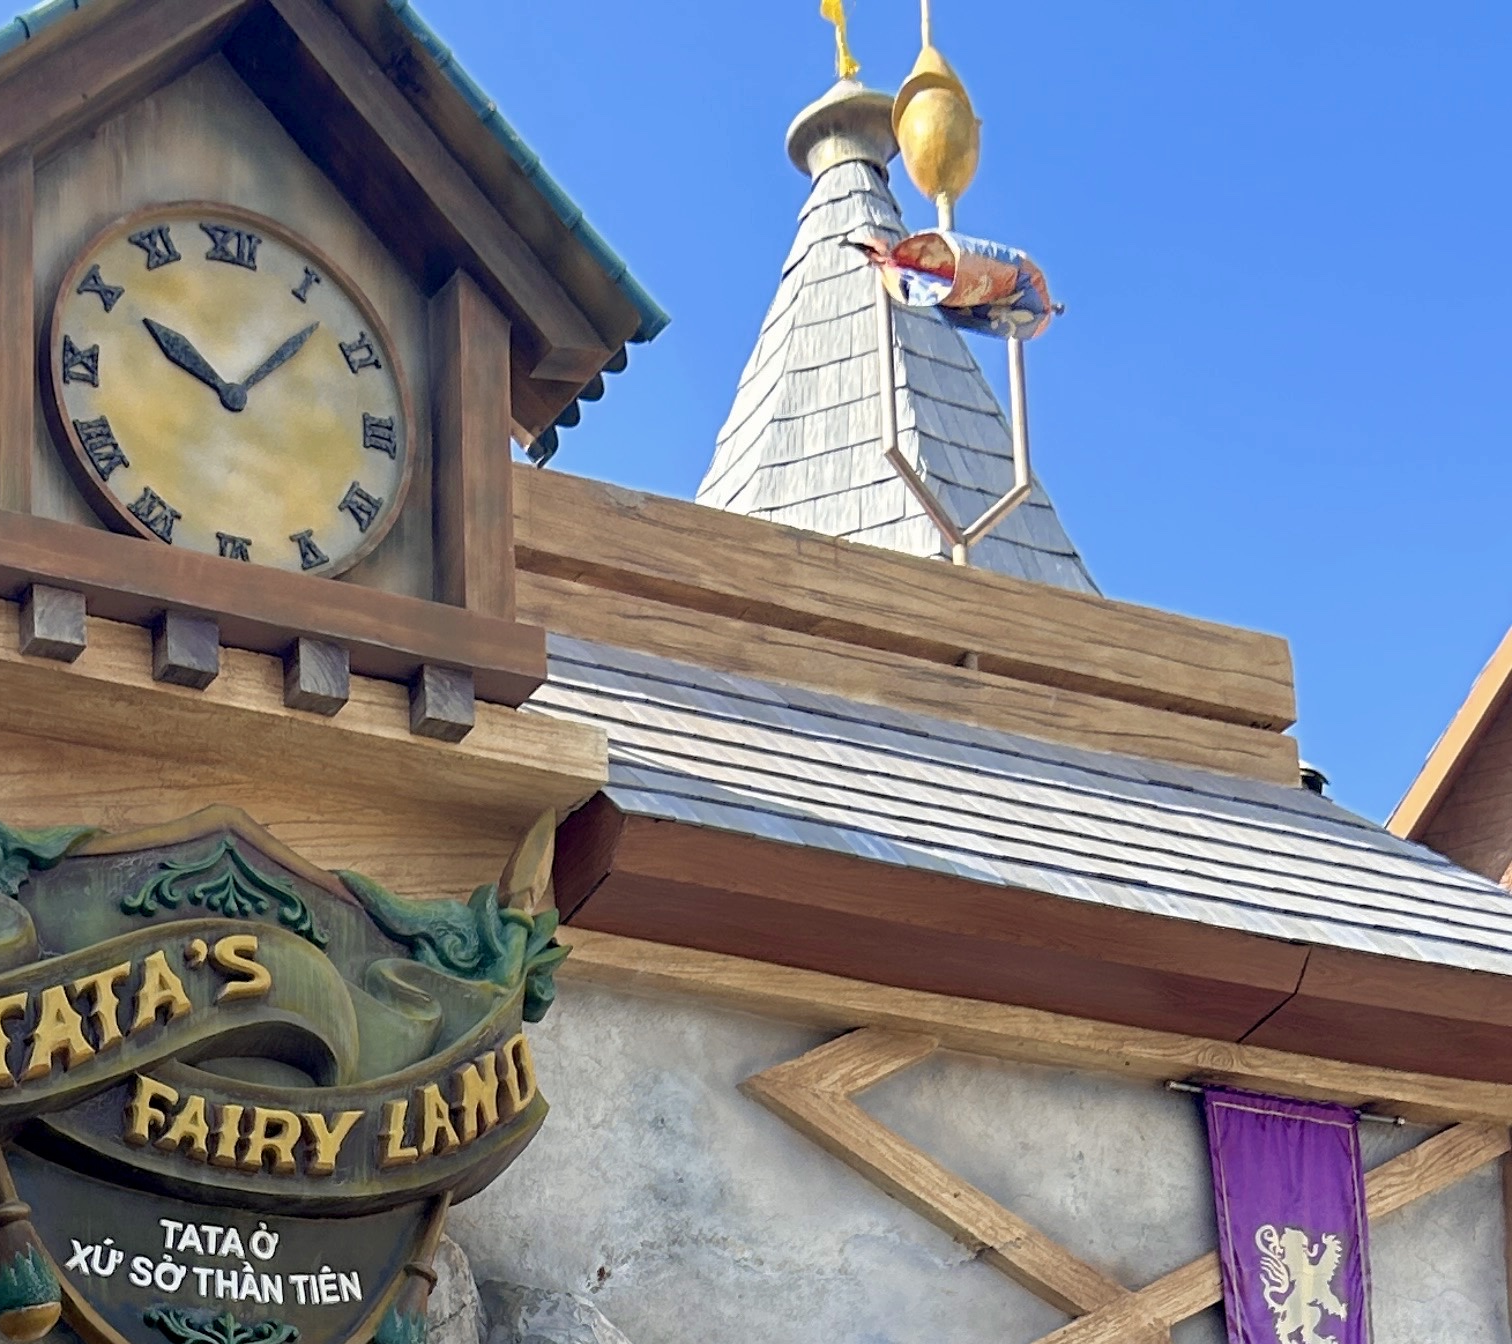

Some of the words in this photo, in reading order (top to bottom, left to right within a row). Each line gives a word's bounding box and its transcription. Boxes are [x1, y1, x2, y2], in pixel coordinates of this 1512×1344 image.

[128, 225, 181, 271] XI
[199, 222, 262, 272] XII
[76, 263, 125, 314] X
[291, 266, 321, 304] I
[62, 334, 100, 388] IX
[338, 330, 382, 375] II
[72, 414, 130, 482] VIII
[362, 411, 397, 460] III
[337, 480, 385, 533] IV
[289, 528, 329, 571] V
[125, 1071, 365, 1176] FAIRY
[378, 1033, 538, 1168] LAND
[159, 1218, 246, 1259] TATA
[248, 1221, 280, 1260] Ở
[63, 1238, 125, 1278] XỨ
[129, 1253, 188, 1292] SỞ
[192, 1260, 285, 1305] THẦN
[289, 1265, 363, 1305] TIÊN
